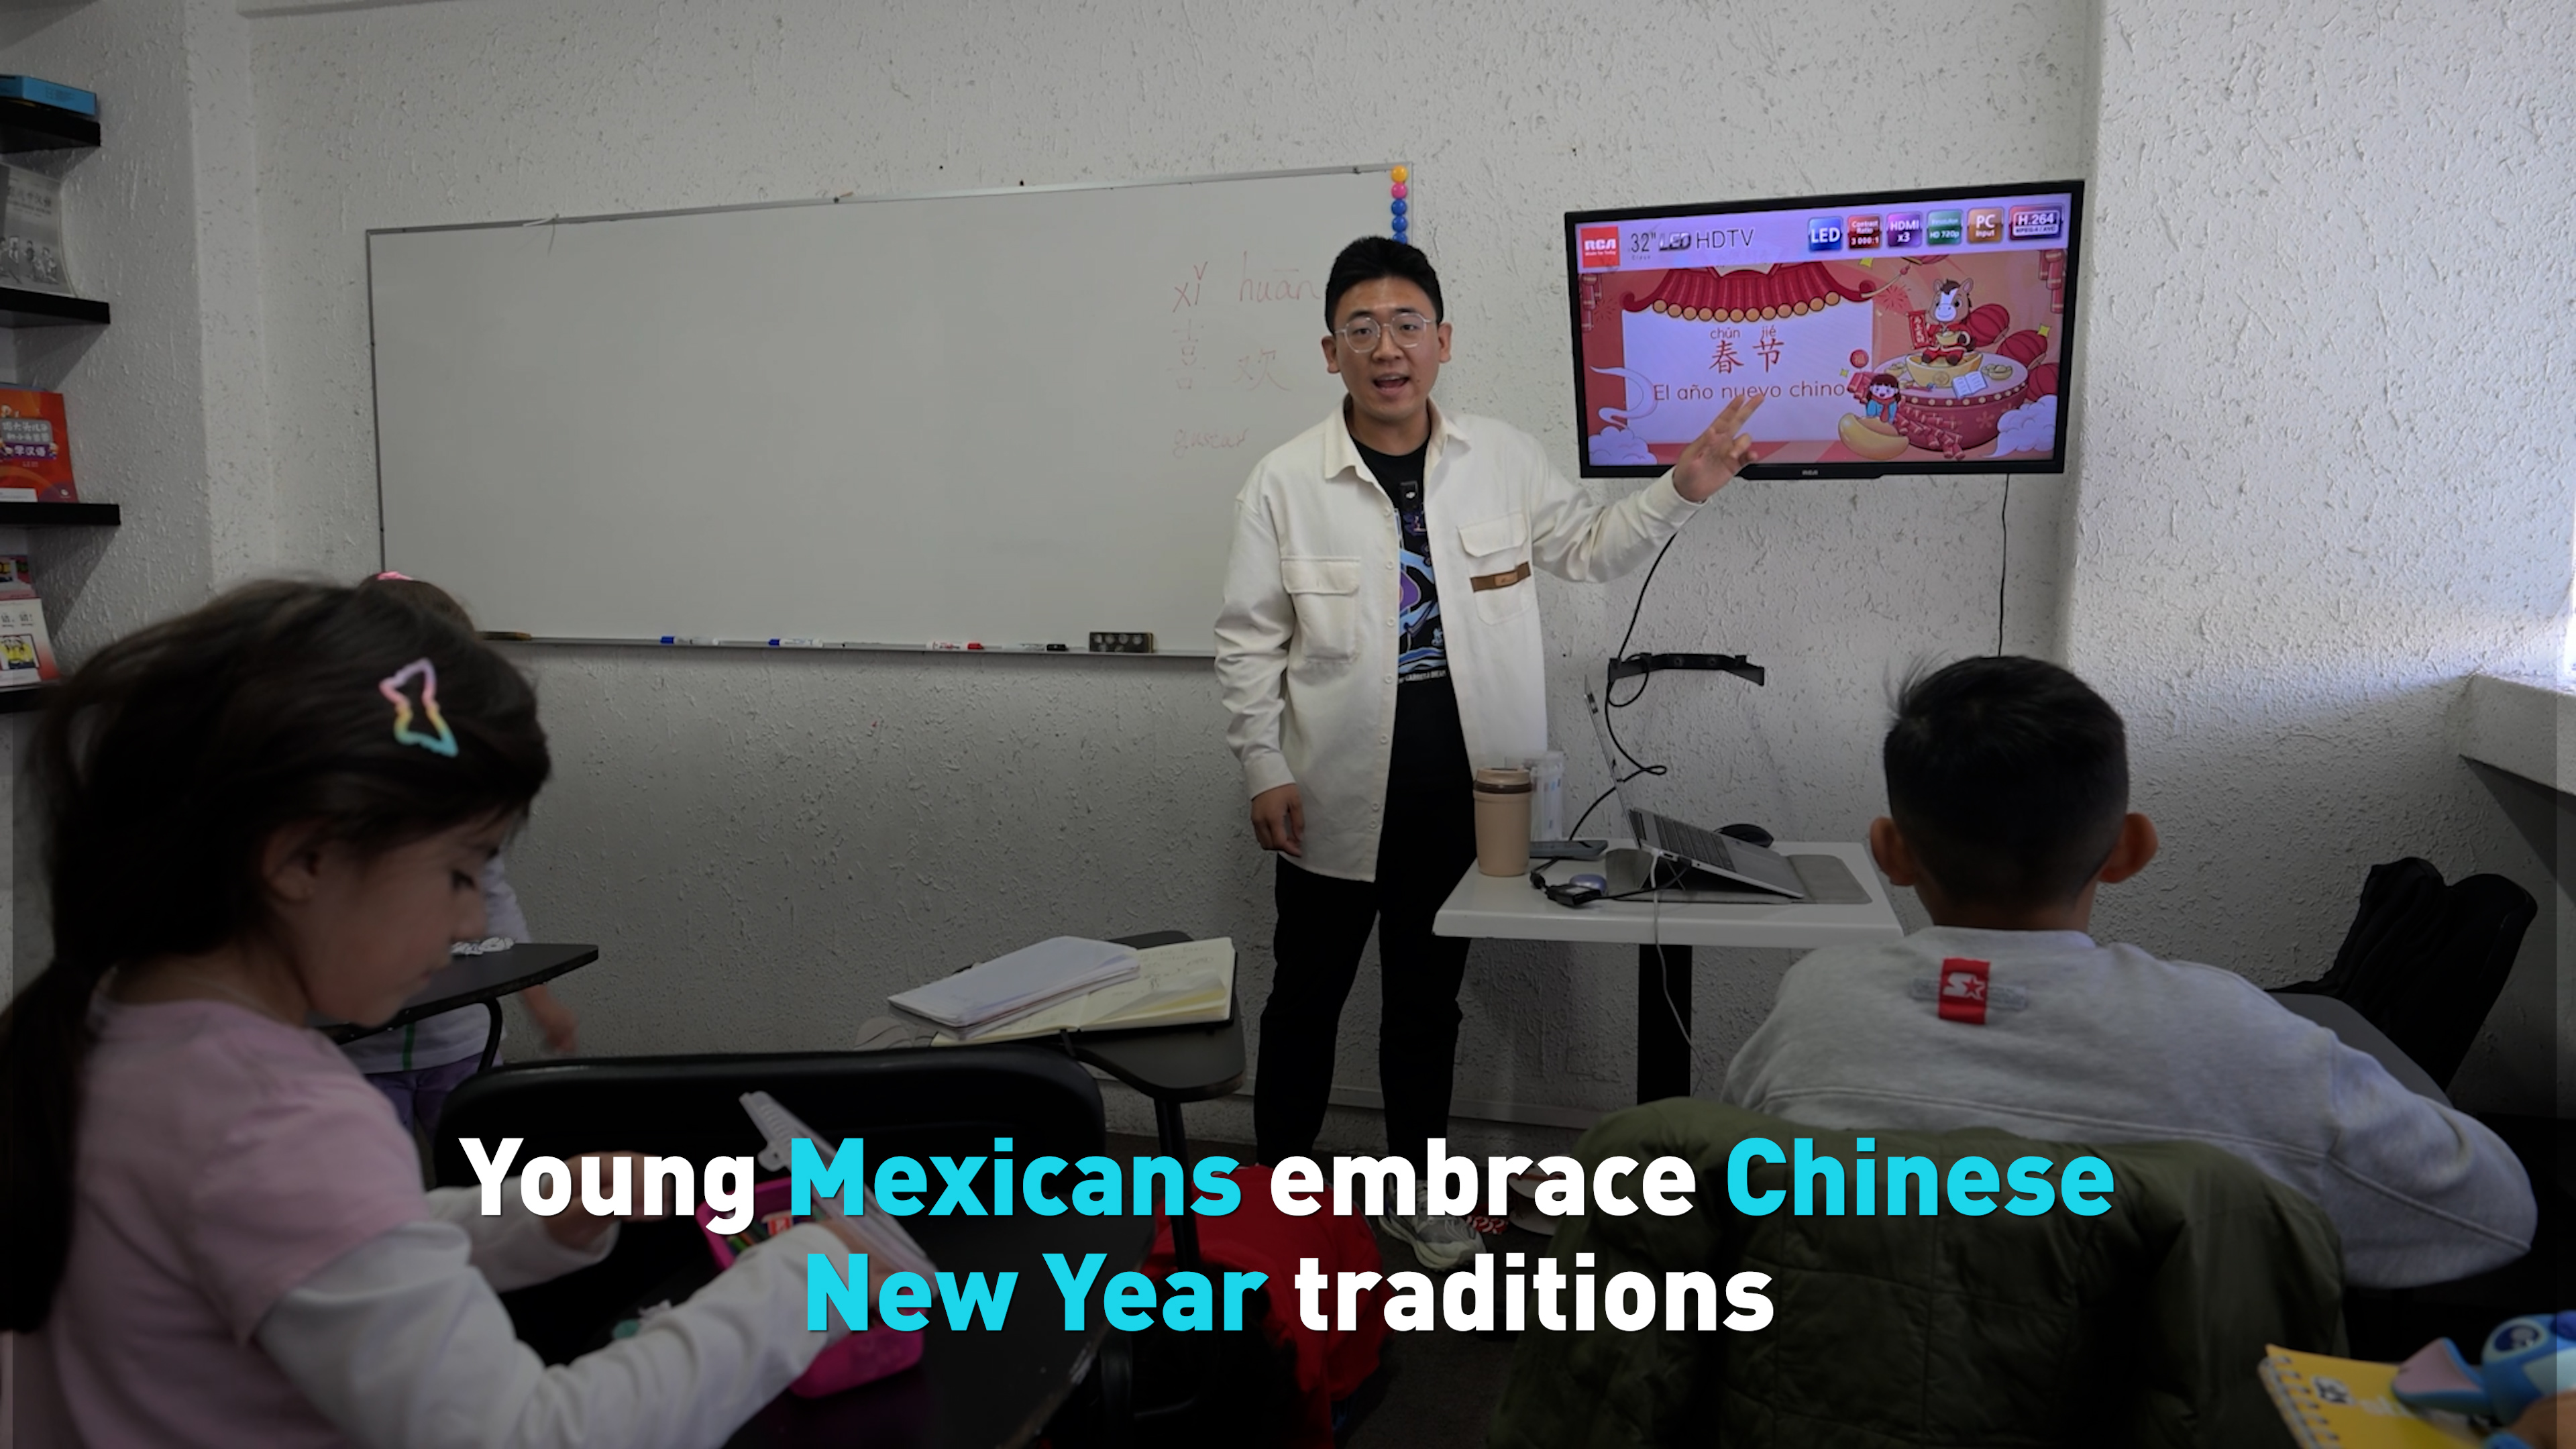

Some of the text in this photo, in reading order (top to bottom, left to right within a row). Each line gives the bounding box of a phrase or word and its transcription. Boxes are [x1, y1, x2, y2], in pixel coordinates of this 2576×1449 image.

[1890, 219, 1920, 231] HDMI
[1976, 213, 1996, 228] PC
[2018, 213, 2054, 225] H.264
[1631, 229, 1754, 252] 32" LED HDTV
[1811, 227, 1841, 243] LED
[1897, 232, 1911, 243] x3
[1941, 230, 1960, 239] 720p
[1585, 238, 1617, 251] RCA
[1709, 339, 1784, 374] 春节
[1654, 380, 1844, 401] El año nuevo chino
[14, 445, 46, 457] 学汉语
